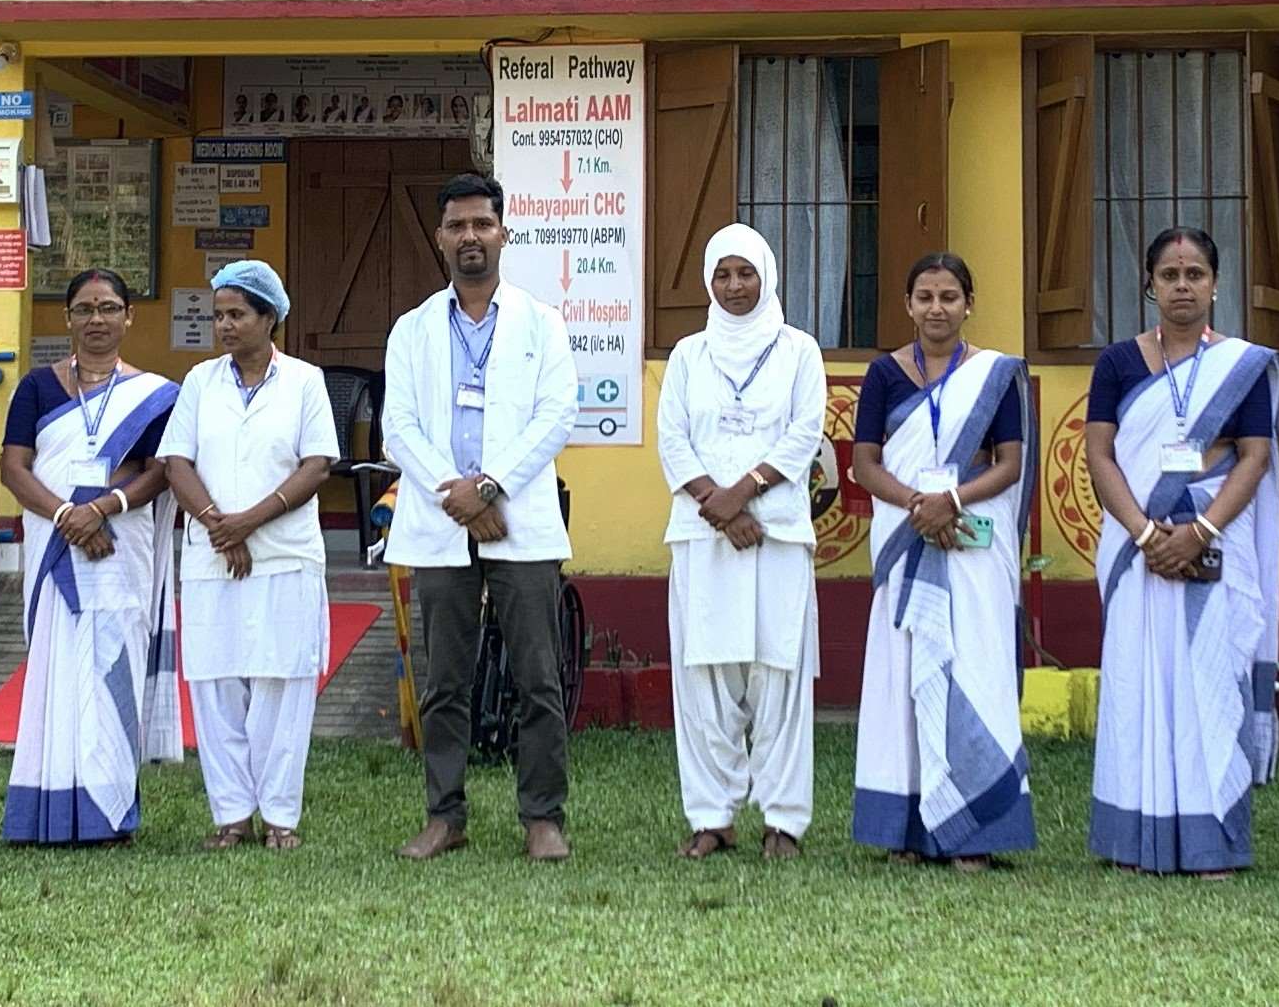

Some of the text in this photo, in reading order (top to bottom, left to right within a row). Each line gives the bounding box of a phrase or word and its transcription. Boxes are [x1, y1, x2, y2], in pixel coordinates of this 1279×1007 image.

[499, 55, 635, 83] Referal Pathway
[1, 95, 21, 105] NO
[505, 95, 631, 122] Lalmati AAM
[512, 128, 623, 148] Cont. 9954757032 (CHO)
[577, 157, 612, 173] 7.1 Km.
[508, 193, 625, 222] Abhayapuri CHC
[534, 227, 588, 245] 7099199770
[591, 227, 625, 248] (ABPM)
[577, 257, 616, 273] 20.4 Km.
[563, 299, 631, 327] Civil Hospital
[569, 335, 624, 355] 842 (i/c HA)
